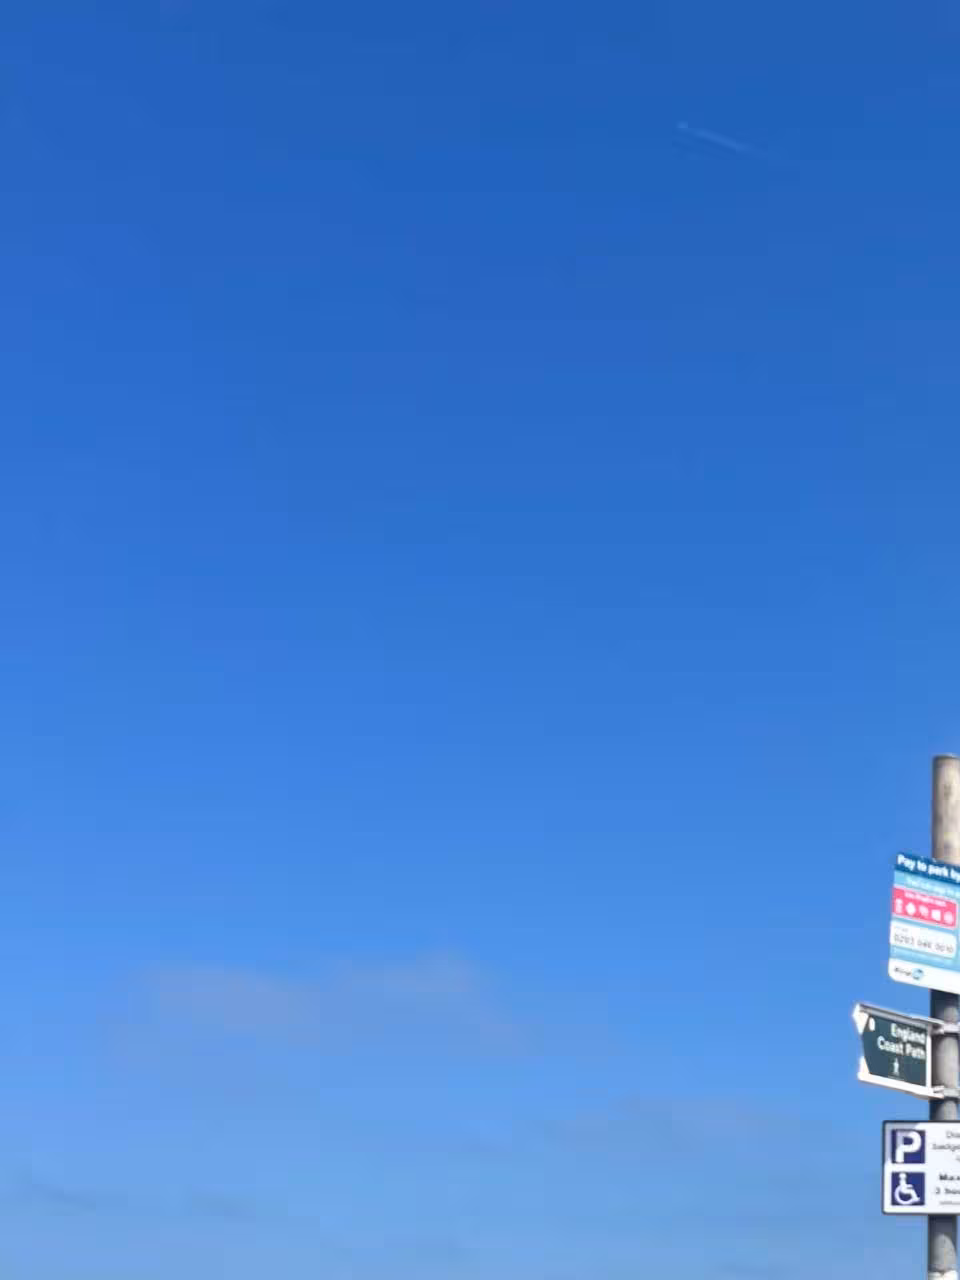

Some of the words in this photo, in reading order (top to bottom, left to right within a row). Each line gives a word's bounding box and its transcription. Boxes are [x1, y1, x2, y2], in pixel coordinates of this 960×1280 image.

[897, 854, 915, 871] Pay
[917, 860, 927, 872] to
[928, 864, 949, 877] park
[890, 1022, 926, 1044] England
[877, 1035, 904, 1055] Coast
[905, 1042, 926, 1060] Path
[896, 1131, 922, 1163] P
